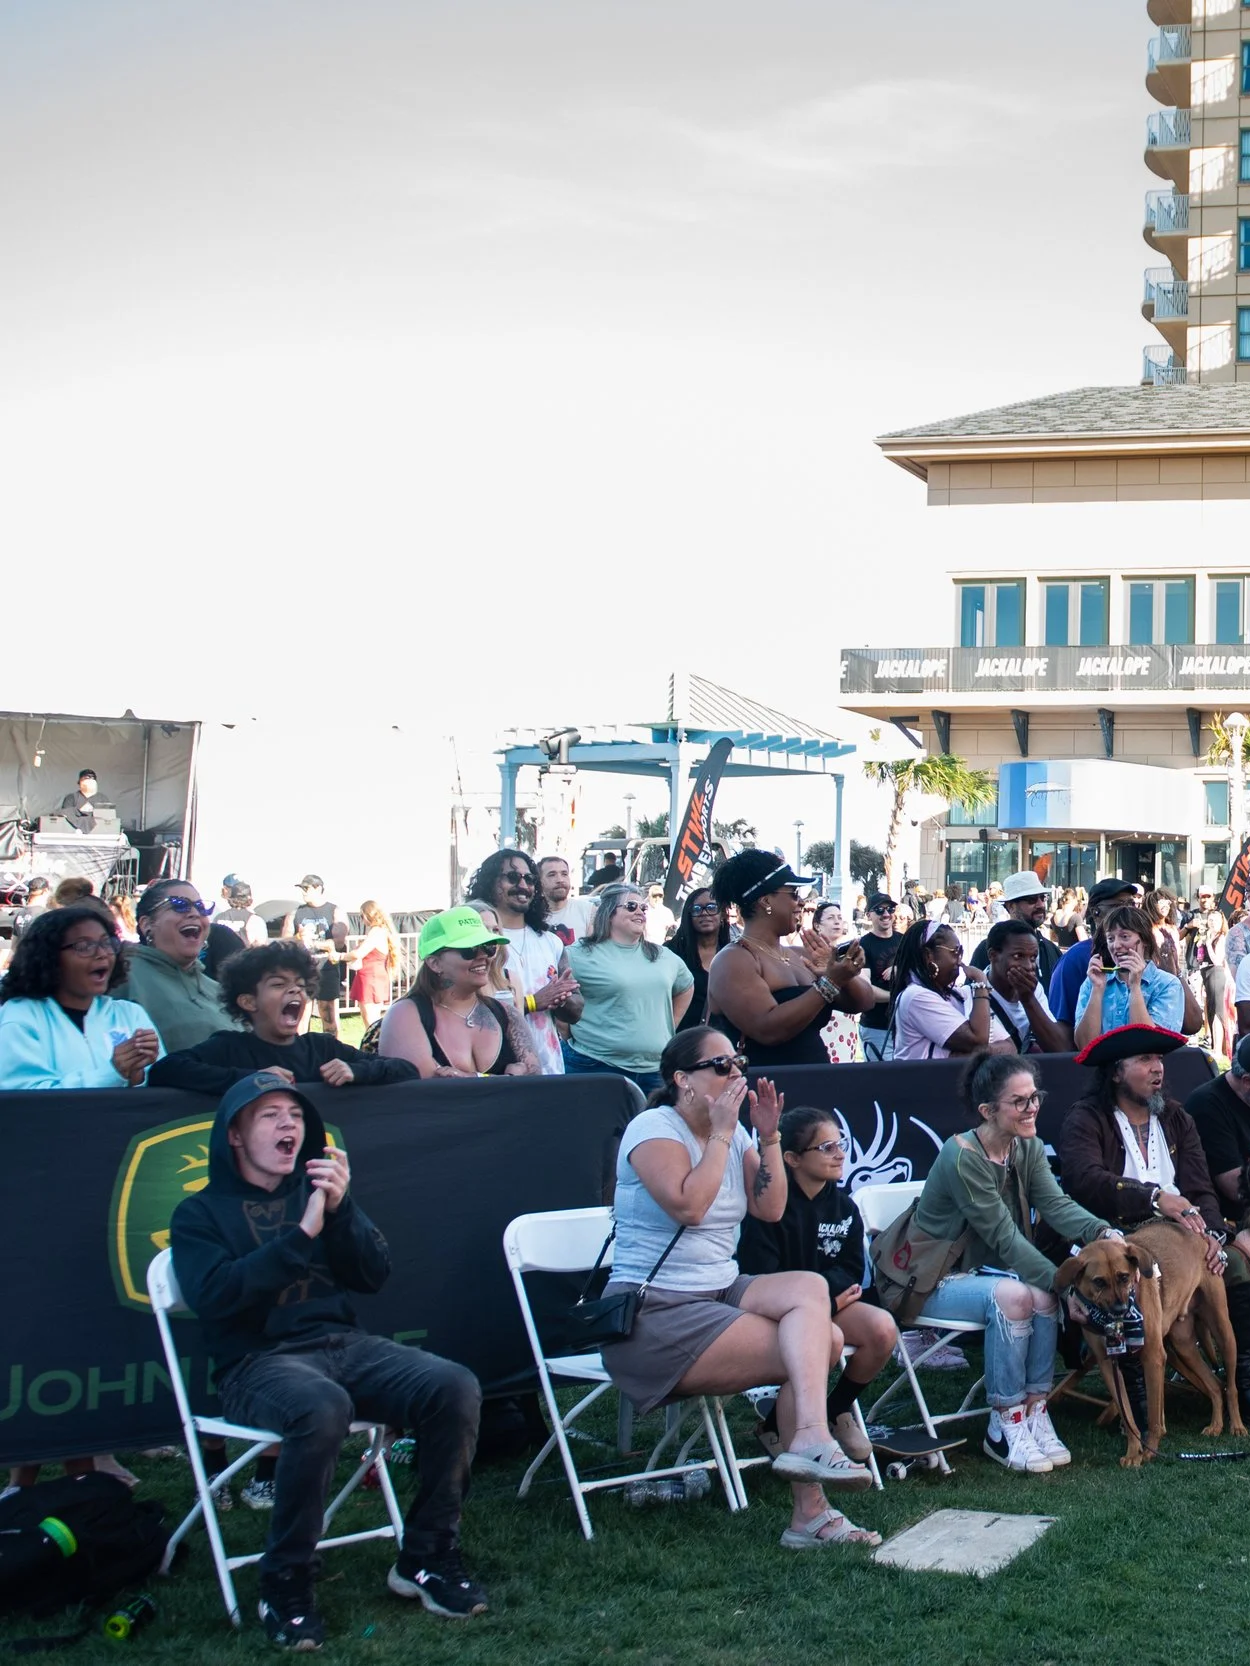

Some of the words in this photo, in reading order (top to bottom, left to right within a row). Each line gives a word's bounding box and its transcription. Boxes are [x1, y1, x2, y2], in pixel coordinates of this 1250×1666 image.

[874, 659, 948, 679] JACKALOPE
[975, 657, 1049, 677] JACKALOPE
[1076, 656, 1151, 676] JACKALOPE
